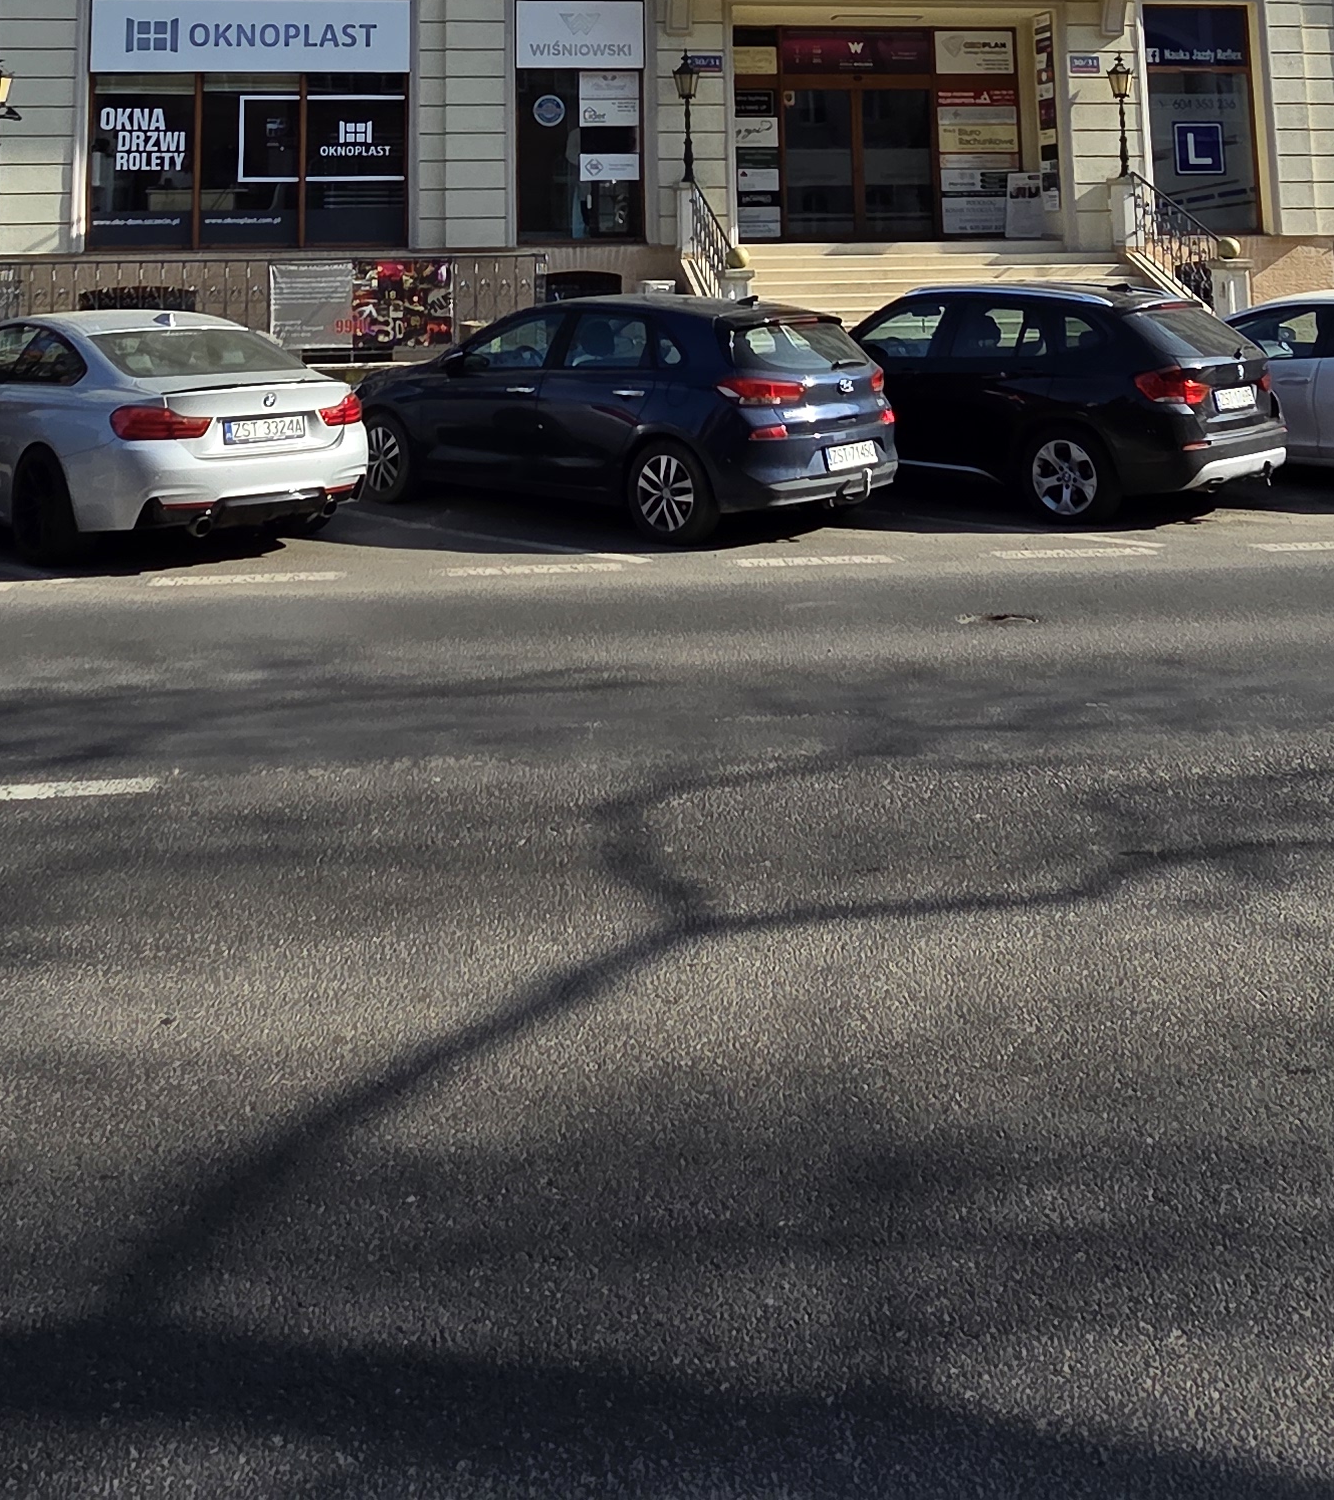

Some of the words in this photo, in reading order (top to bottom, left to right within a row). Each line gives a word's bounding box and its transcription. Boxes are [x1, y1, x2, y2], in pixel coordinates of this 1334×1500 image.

[189, 22, 378, 48] OKNOPLAST
[529, 40, 632, 57] WIŚNIOWSKI
[1164, 48, 1190, 60] Nauka
[99, 107, 166, 131] OKNA
[117, 131, 186, 151] DRZWI
[1186, 132, 1213, 165] L
[320, 145, 391, 157] OKNOPLAST
[115, 152, 185, 171] ROLETY
[232, 421, 258, 438] ZST
[263, 418, 303, 436] 3324A
[831, 447, 849, 464] ZST
